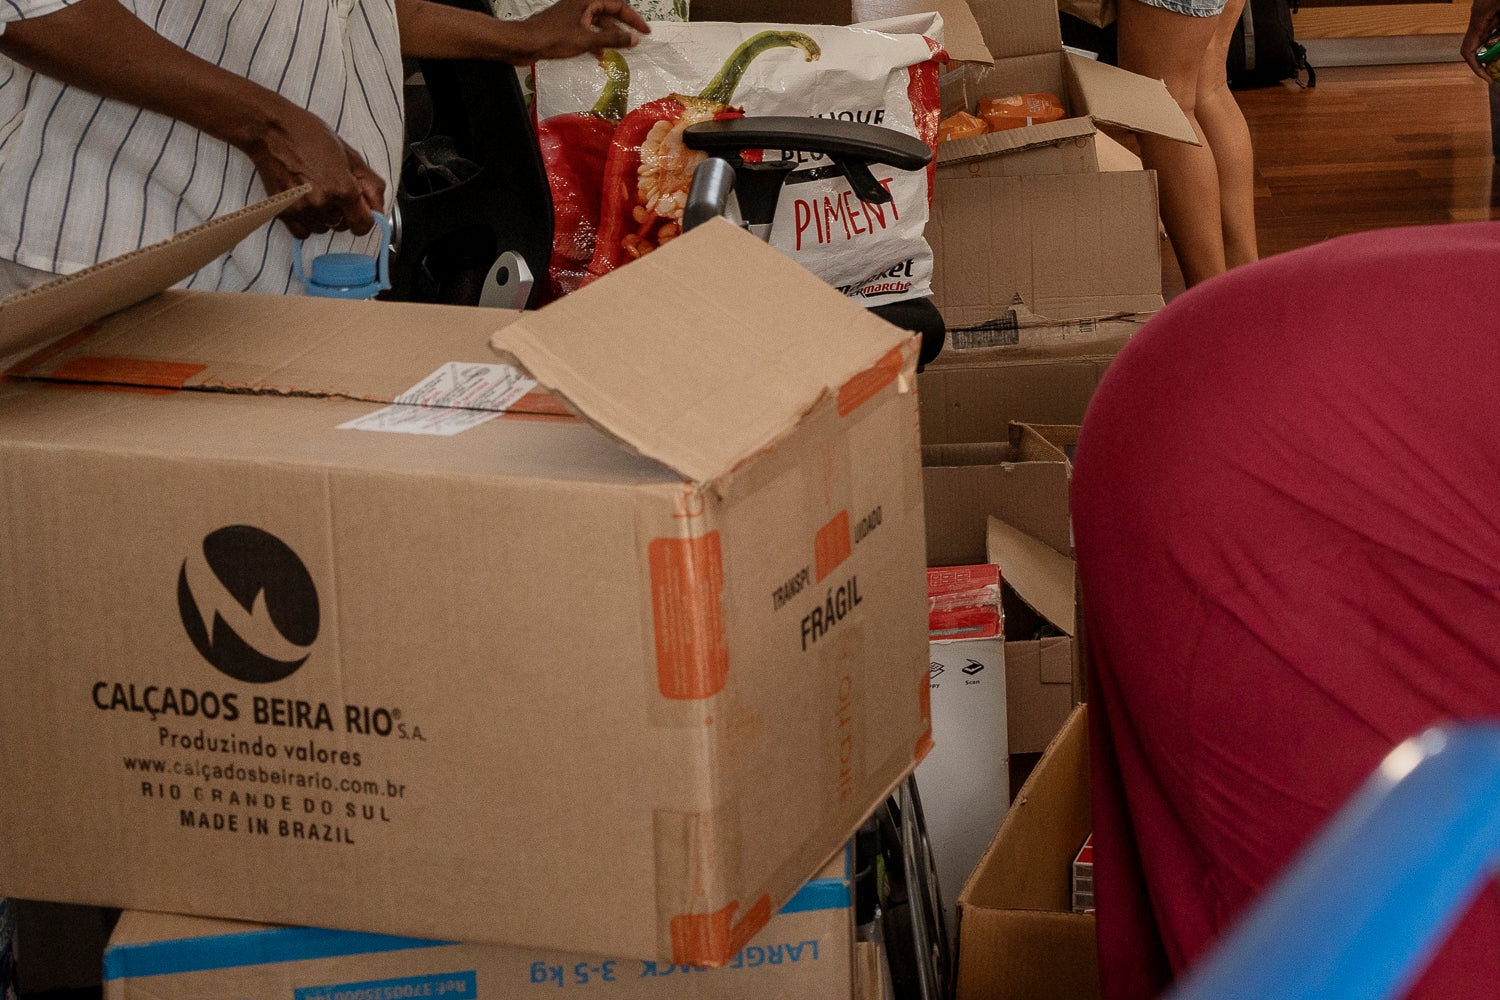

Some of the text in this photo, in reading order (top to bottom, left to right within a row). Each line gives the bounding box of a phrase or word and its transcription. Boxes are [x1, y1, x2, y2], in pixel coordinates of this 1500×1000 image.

[794, 177, 899, 252] PIMENT
[854, 505, 883, 544] UIDADO
[801, 575, 863, 652] FRÁGIL
[92, 682, 240, 721] CALÇADOS
[253, 696, 334, 731] BEIRA
[398, 722, 427, 742] S.A.
[159, 727, 362, 767] Produzindo valores
[141, 781, 182, 801] RIO
[303, 798, 333, 816] DO
[346, 802, 391, 823] SUL
[180, 809, 355, 845] MADE IN BRAZIL
[530, 961, 566, 987] kg
[574, 960, 617, 987] 3-5
